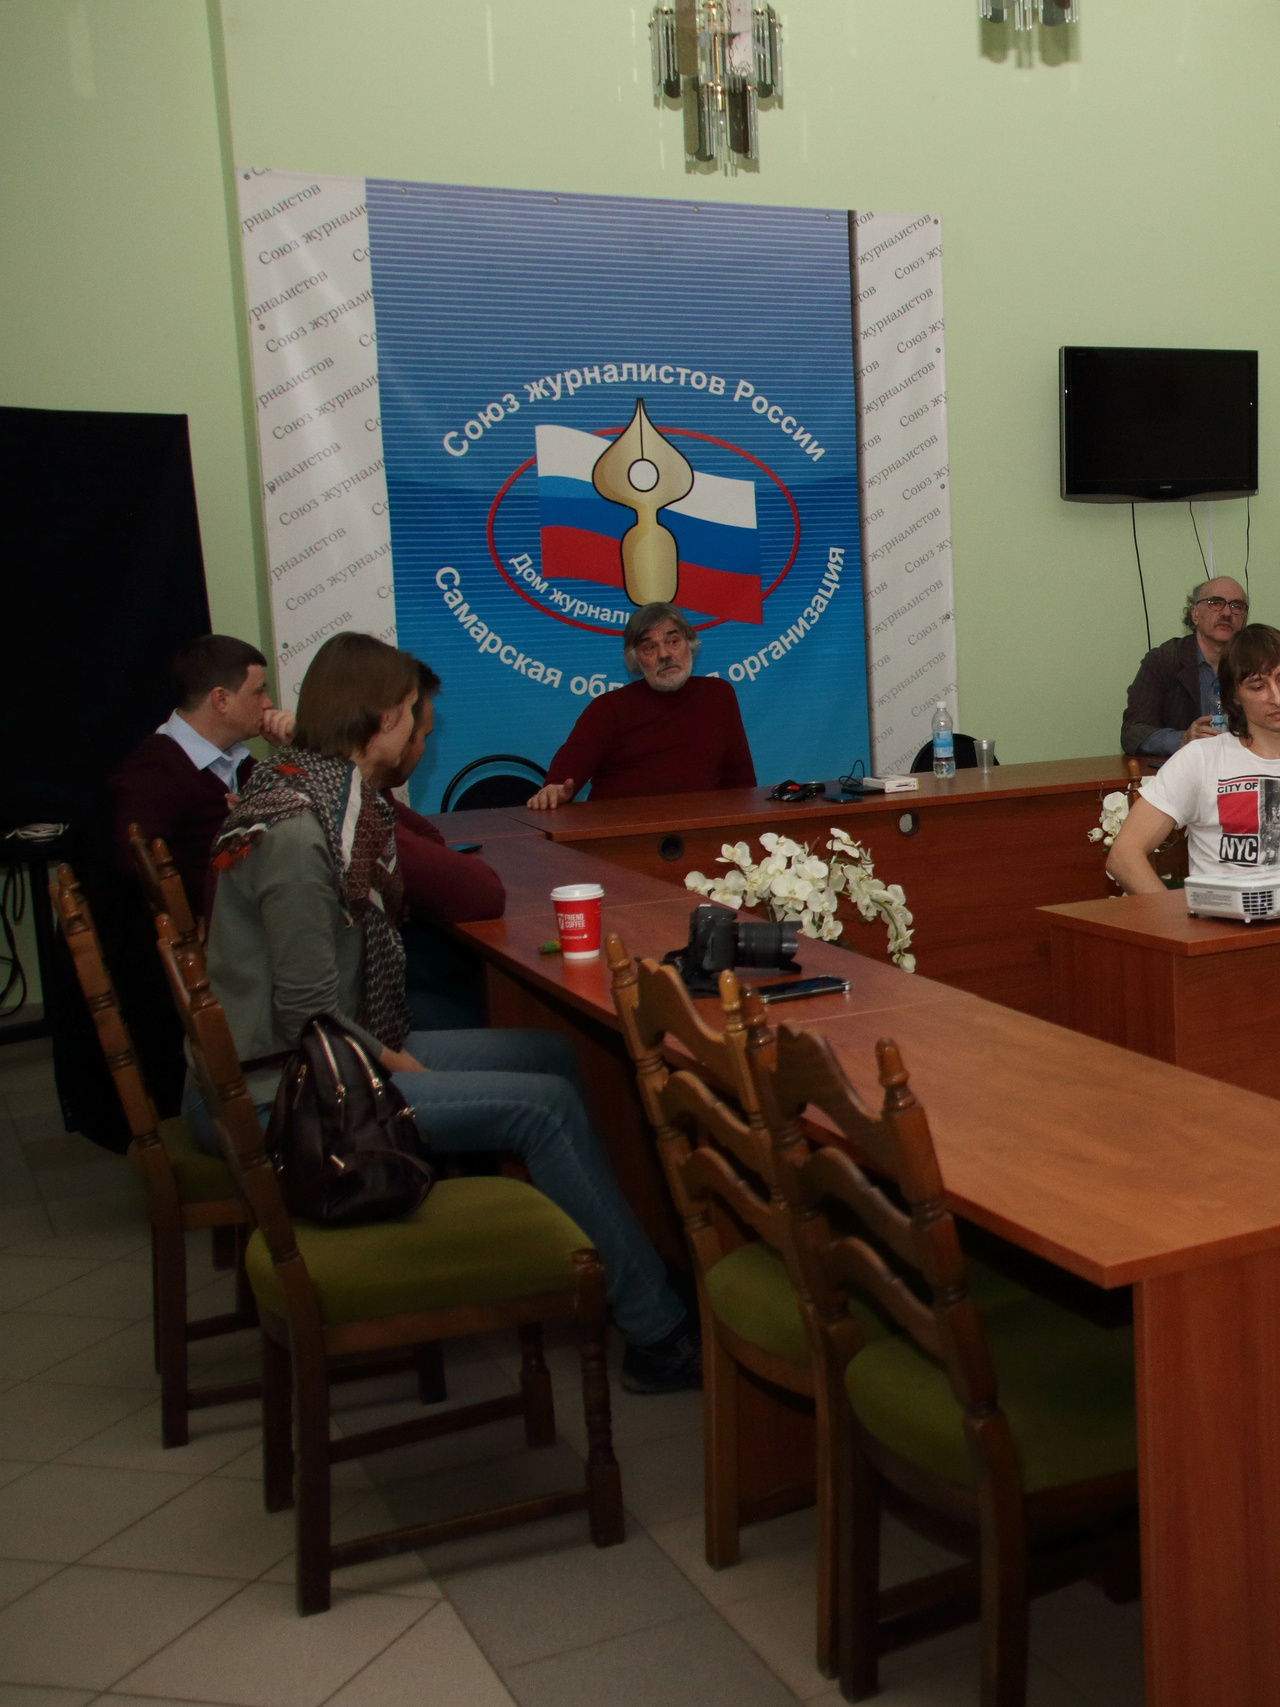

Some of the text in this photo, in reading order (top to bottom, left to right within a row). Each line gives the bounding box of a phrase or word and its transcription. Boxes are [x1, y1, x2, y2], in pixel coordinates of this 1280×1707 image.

[241, 184, 321, 235] рналистов
[258, 204, 368, 265] Союз журнали
[857, 213, 932, 265] журналистов
[894, 256, 925, 279] Союз
[249, 270, 328, 323] рналистов
[265, 288, 373, 353] Союз журнали
[860, 287, 934, 341] журналистов
[896, 330, 927, 354] Союз
[256, 357, 335, 412] рналистов
[272, 374, 379, 440] Союз журнали
[863, 361, 936, 415] журналистов
[442, 362, 826, 463] Союз журналистов России
[899, 403, 930, 428] Союз
[263, 442, 341, 500] рналистов
[865, 434, 938, 491] журналистов
[902, 477, 932, 501] Союз
[279, 458, 386, 526] Союз журнали
[270, 527, 347, 585] рналистов
[868, 507, 941, 564] журналистов
[905, 549, 935, 574] Союз
[285, 541, 392, 611] Союз журнали
[508, 552, 549, 596] Дом
[434, 565, 562, 690] Самарская
[727, 545, 846, 684] организация
[874, 579, 944, 636] журналистов
[908, 621, 938, 646] Союз
[876, 651, 946, 708] журналистов
[911, 692, 941, 718] Союз
[1217, 781, 1259, 794] CITY OF
[1220, 836, 1258, 862] NYC
[564, 920, 586, 929] COFFEE
